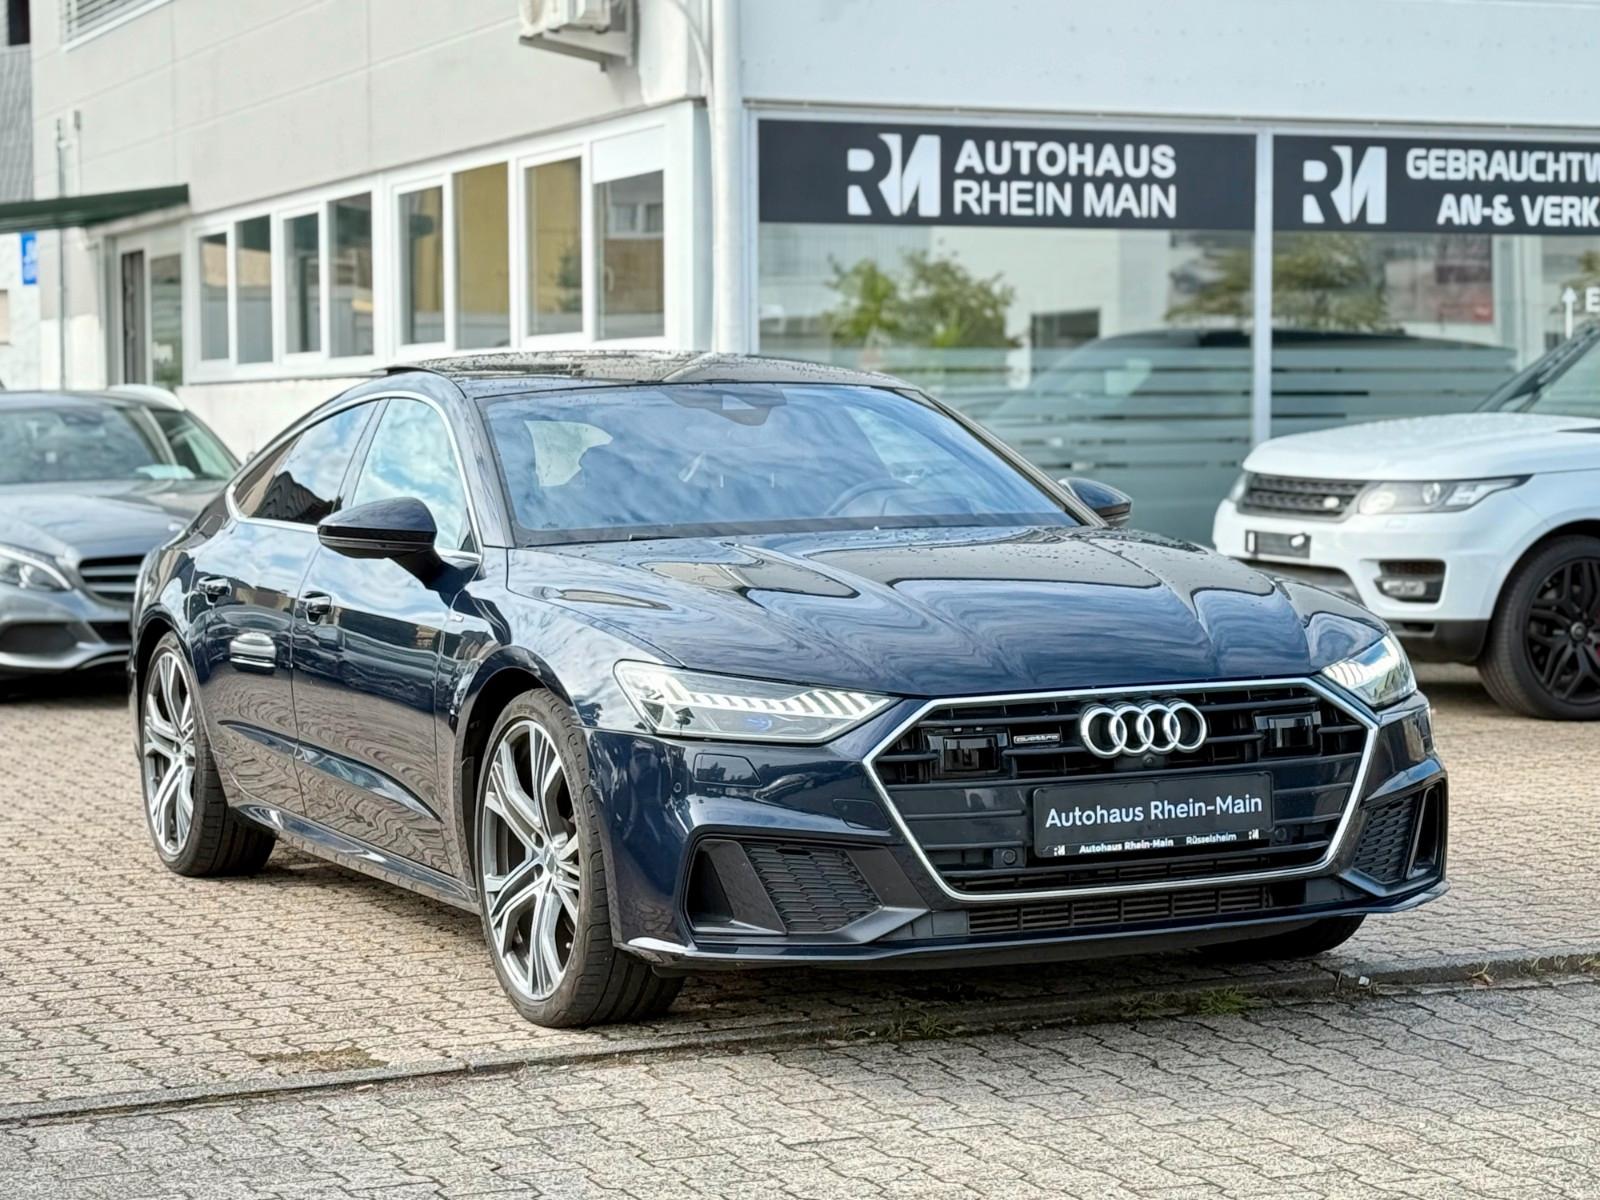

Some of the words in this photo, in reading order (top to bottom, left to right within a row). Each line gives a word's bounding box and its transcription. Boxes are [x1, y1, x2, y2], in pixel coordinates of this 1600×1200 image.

[954, 139, 1177, 179] AUTOHAUS
[953, 179, 1072, 216] RHEIN
[1083, 182, 1177, 218] MAIN
[1520, 195, 1600, 227] VERK
[1045, 805, 1144, 828] Autohaus
[1150, 794, 1262, 820] Rhein-Main
[1079, 843, 1122, 854] Autohaus
[1124, 838, 1174, 850] Rhein-Main
